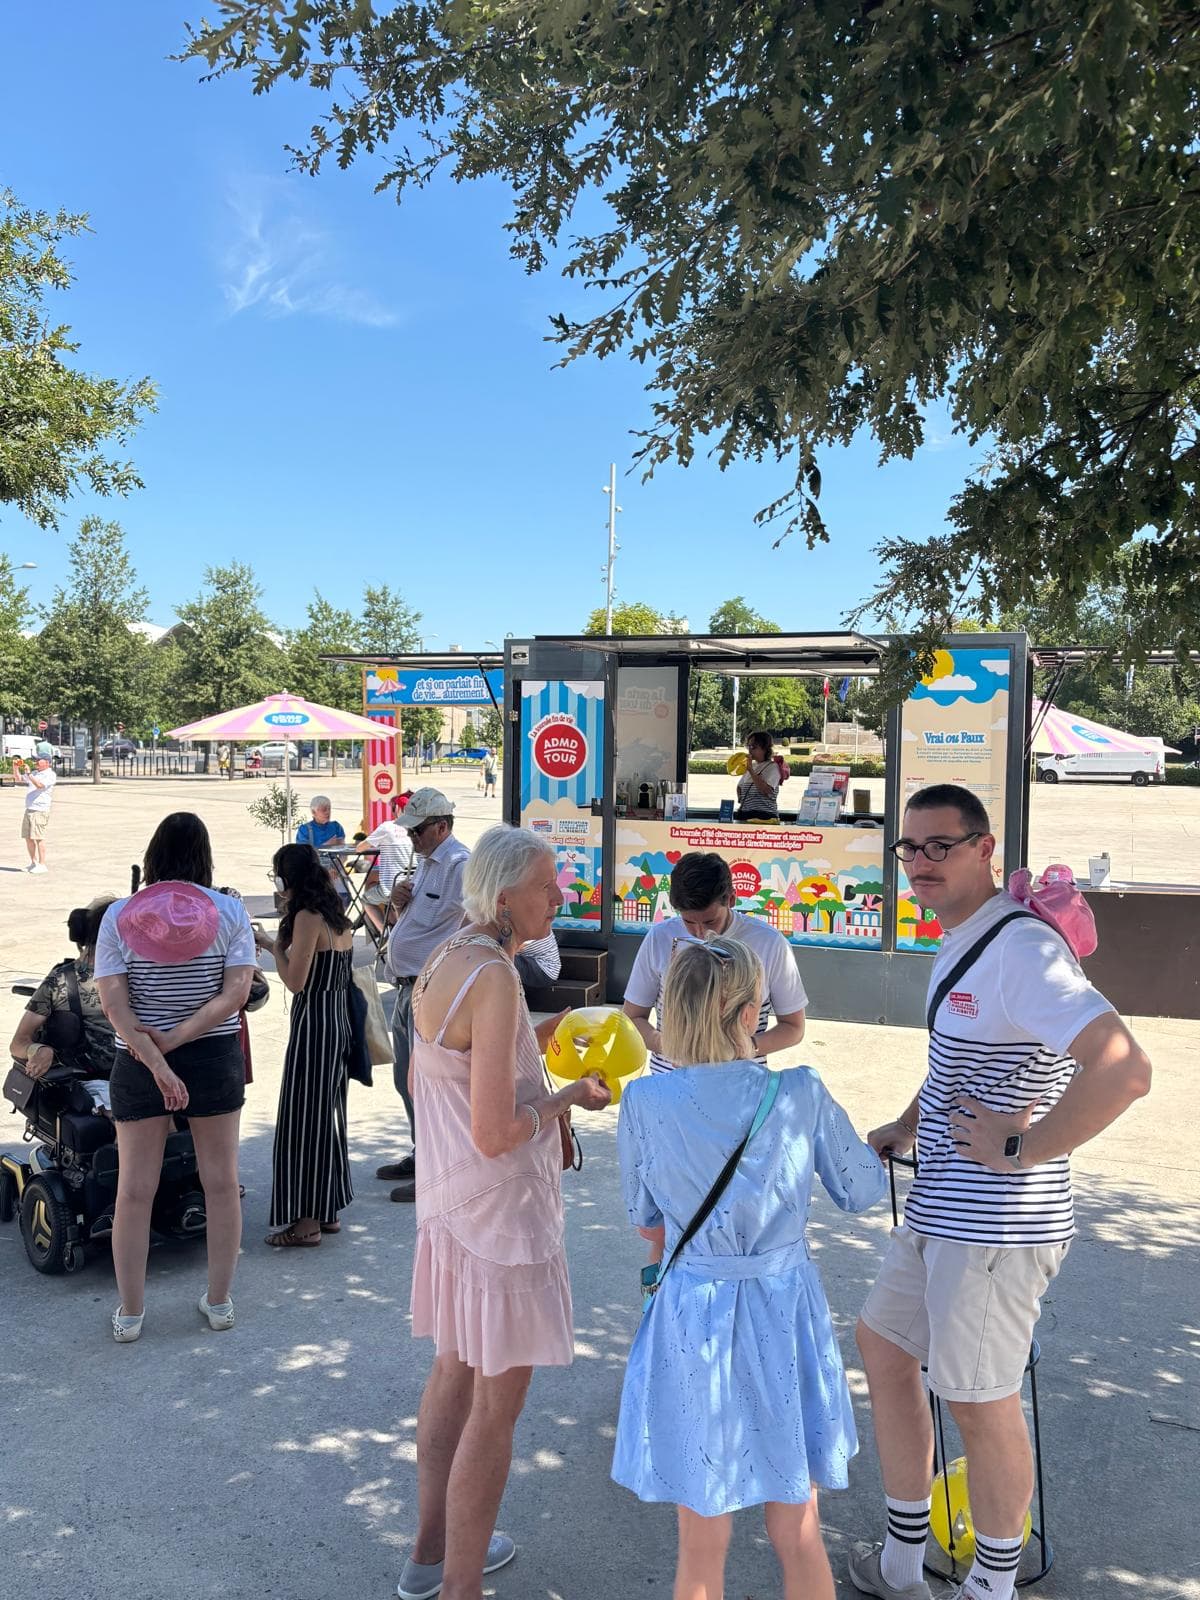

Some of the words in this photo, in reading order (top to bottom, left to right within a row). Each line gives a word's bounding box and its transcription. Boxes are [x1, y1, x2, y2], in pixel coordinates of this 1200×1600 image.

[417, 680, 424, 689] et
[426, 678, 432, 690] si
[434, 680, 444, 690] on
[446, 677, 472, 690] parlait
[474, 676, 485, 688] fin
[413, 689, 423, 699] de
[443, 688, 483, 699] autrement
[544, 737, 579, 750] ADMD
[924, 732, 944, 744] Vrai
[945, 734, 960, 744] ou
[960, 731, 985, 744] Faux
[544, 753, 577, 765] TOUR
[671, 828, 679, 836] La
[680, 828, 701, 837] tournée
[715, 829, 742, 840] citoyenne
[742, 832, 756, 841] pour
[756, 831, 782, 840] informer
[782, 832, 789, 840] et
[714, 838, 721, 846] de
[745, 839, 772, 848] directives
[732, 872, 757, 882] ADMD
